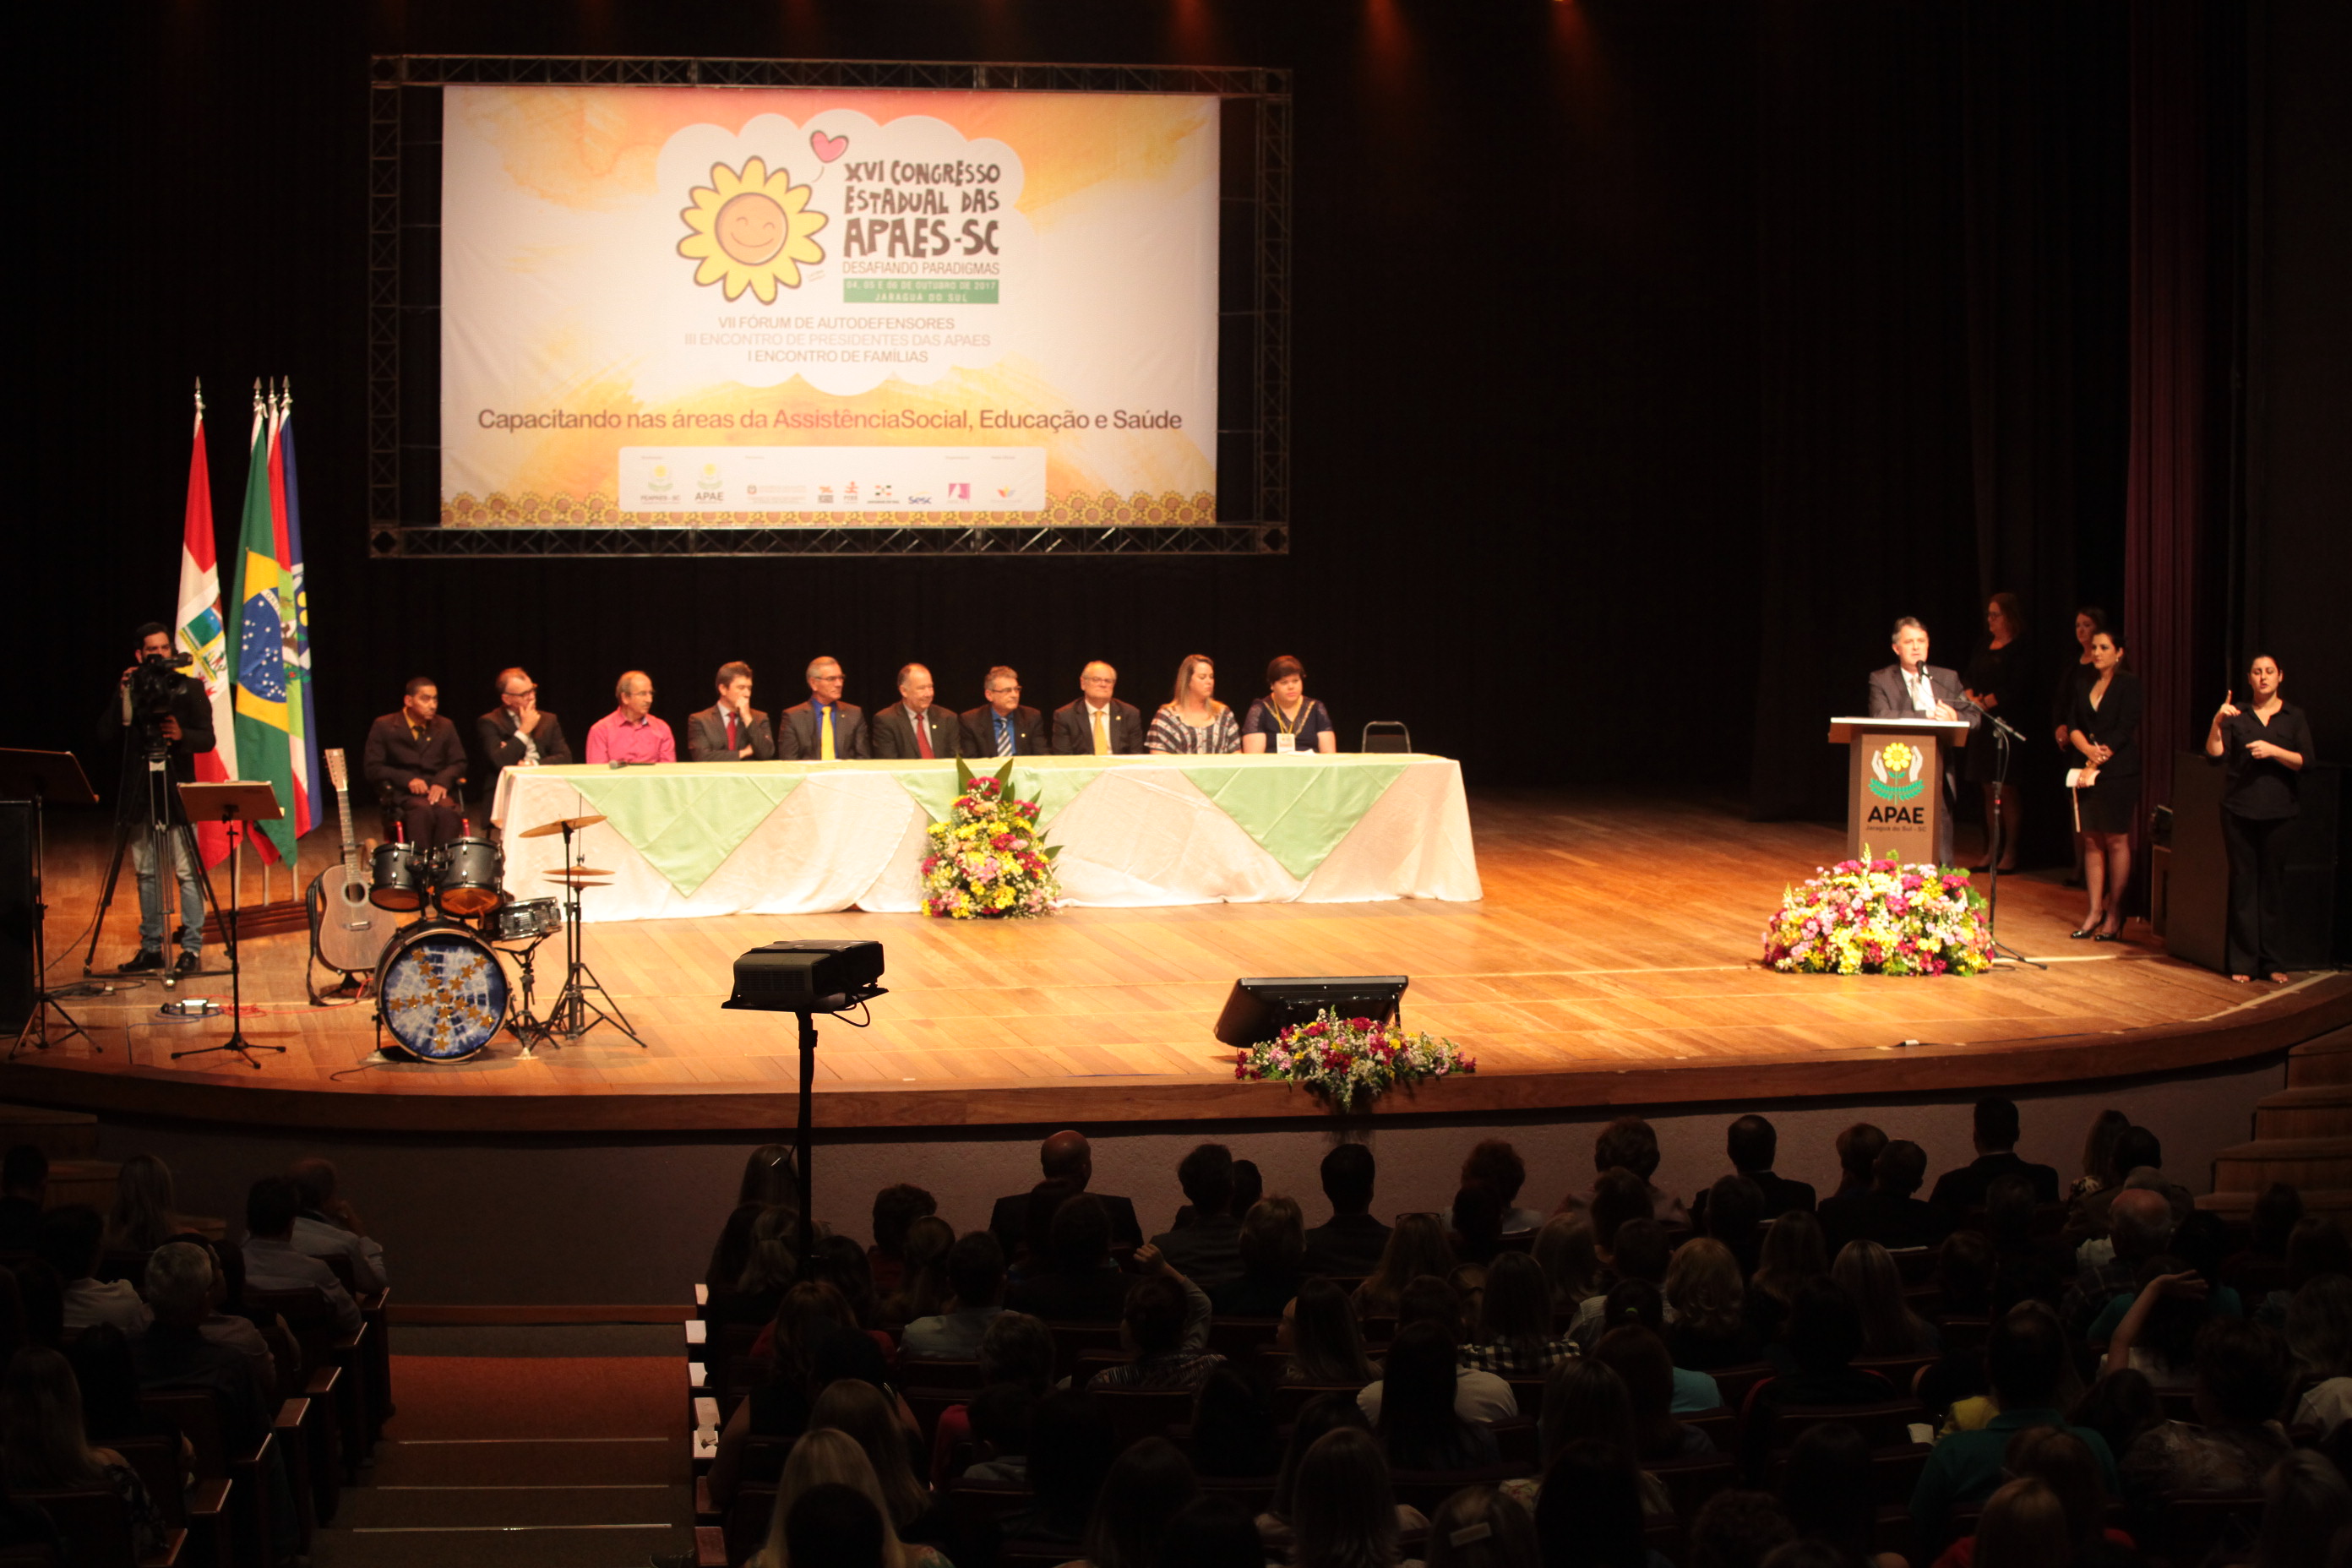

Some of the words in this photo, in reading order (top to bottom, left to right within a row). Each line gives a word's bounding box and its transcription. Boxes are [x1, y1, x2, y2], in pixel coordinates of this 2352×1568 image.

[845, 161, 884, 182] XVI
[890, 160, 1000, 186] CONGRESSO
[845, 186, 950, 215] ESTADUAL
[961, 188, 999, 213] DAS
[844, 217, 999, 259] APAES-SC
[843, 261, 918, 275] DESAFIANDO
[922, 262, 999, 275] PARADIGMAS
[901, 280, 912, 289] DE
[915, 281, 956, 290] OUTUBRO
[960, 281, 971, 290] DE
[974, 281, 996, 290] 2017
[948, 294, 967, 302] SUL
[718, 317, 736, 329] VII
[739, 315, 792, 329] FÓRUM
[795, 317, 814, 329] DE
[818, 317, 956, 329] AUTODEFENSORES
[685, 334, 696, 346] III
[700, 334, 782, 346] ENCONTRO
[787, 334, 805, 346] DE
[808, 334, 909, 346] PRESIDENTES
[912, 335, 940, 346] DAS
[944, 335, 991, 346] APAES
[754, 351, 837, 362] ENCONTRO
[841, 351, 860, 362] DE
[863, 349, 928, 362] FAMÍLIAS
[478, 409, 622, 433] Capacitando
[628, 414, 666, 428] nas
[672, 409, 733, 428] áreas
[740, 409, 766, 428] da
[981, 409, 1090, 433] Educação
[1095, 414, 1108, 428] e
[1113, 409, 1182, 428] Saúde
[694, 492, 724, 501] APAE
[1868, 806, 1925, 824] APAE
